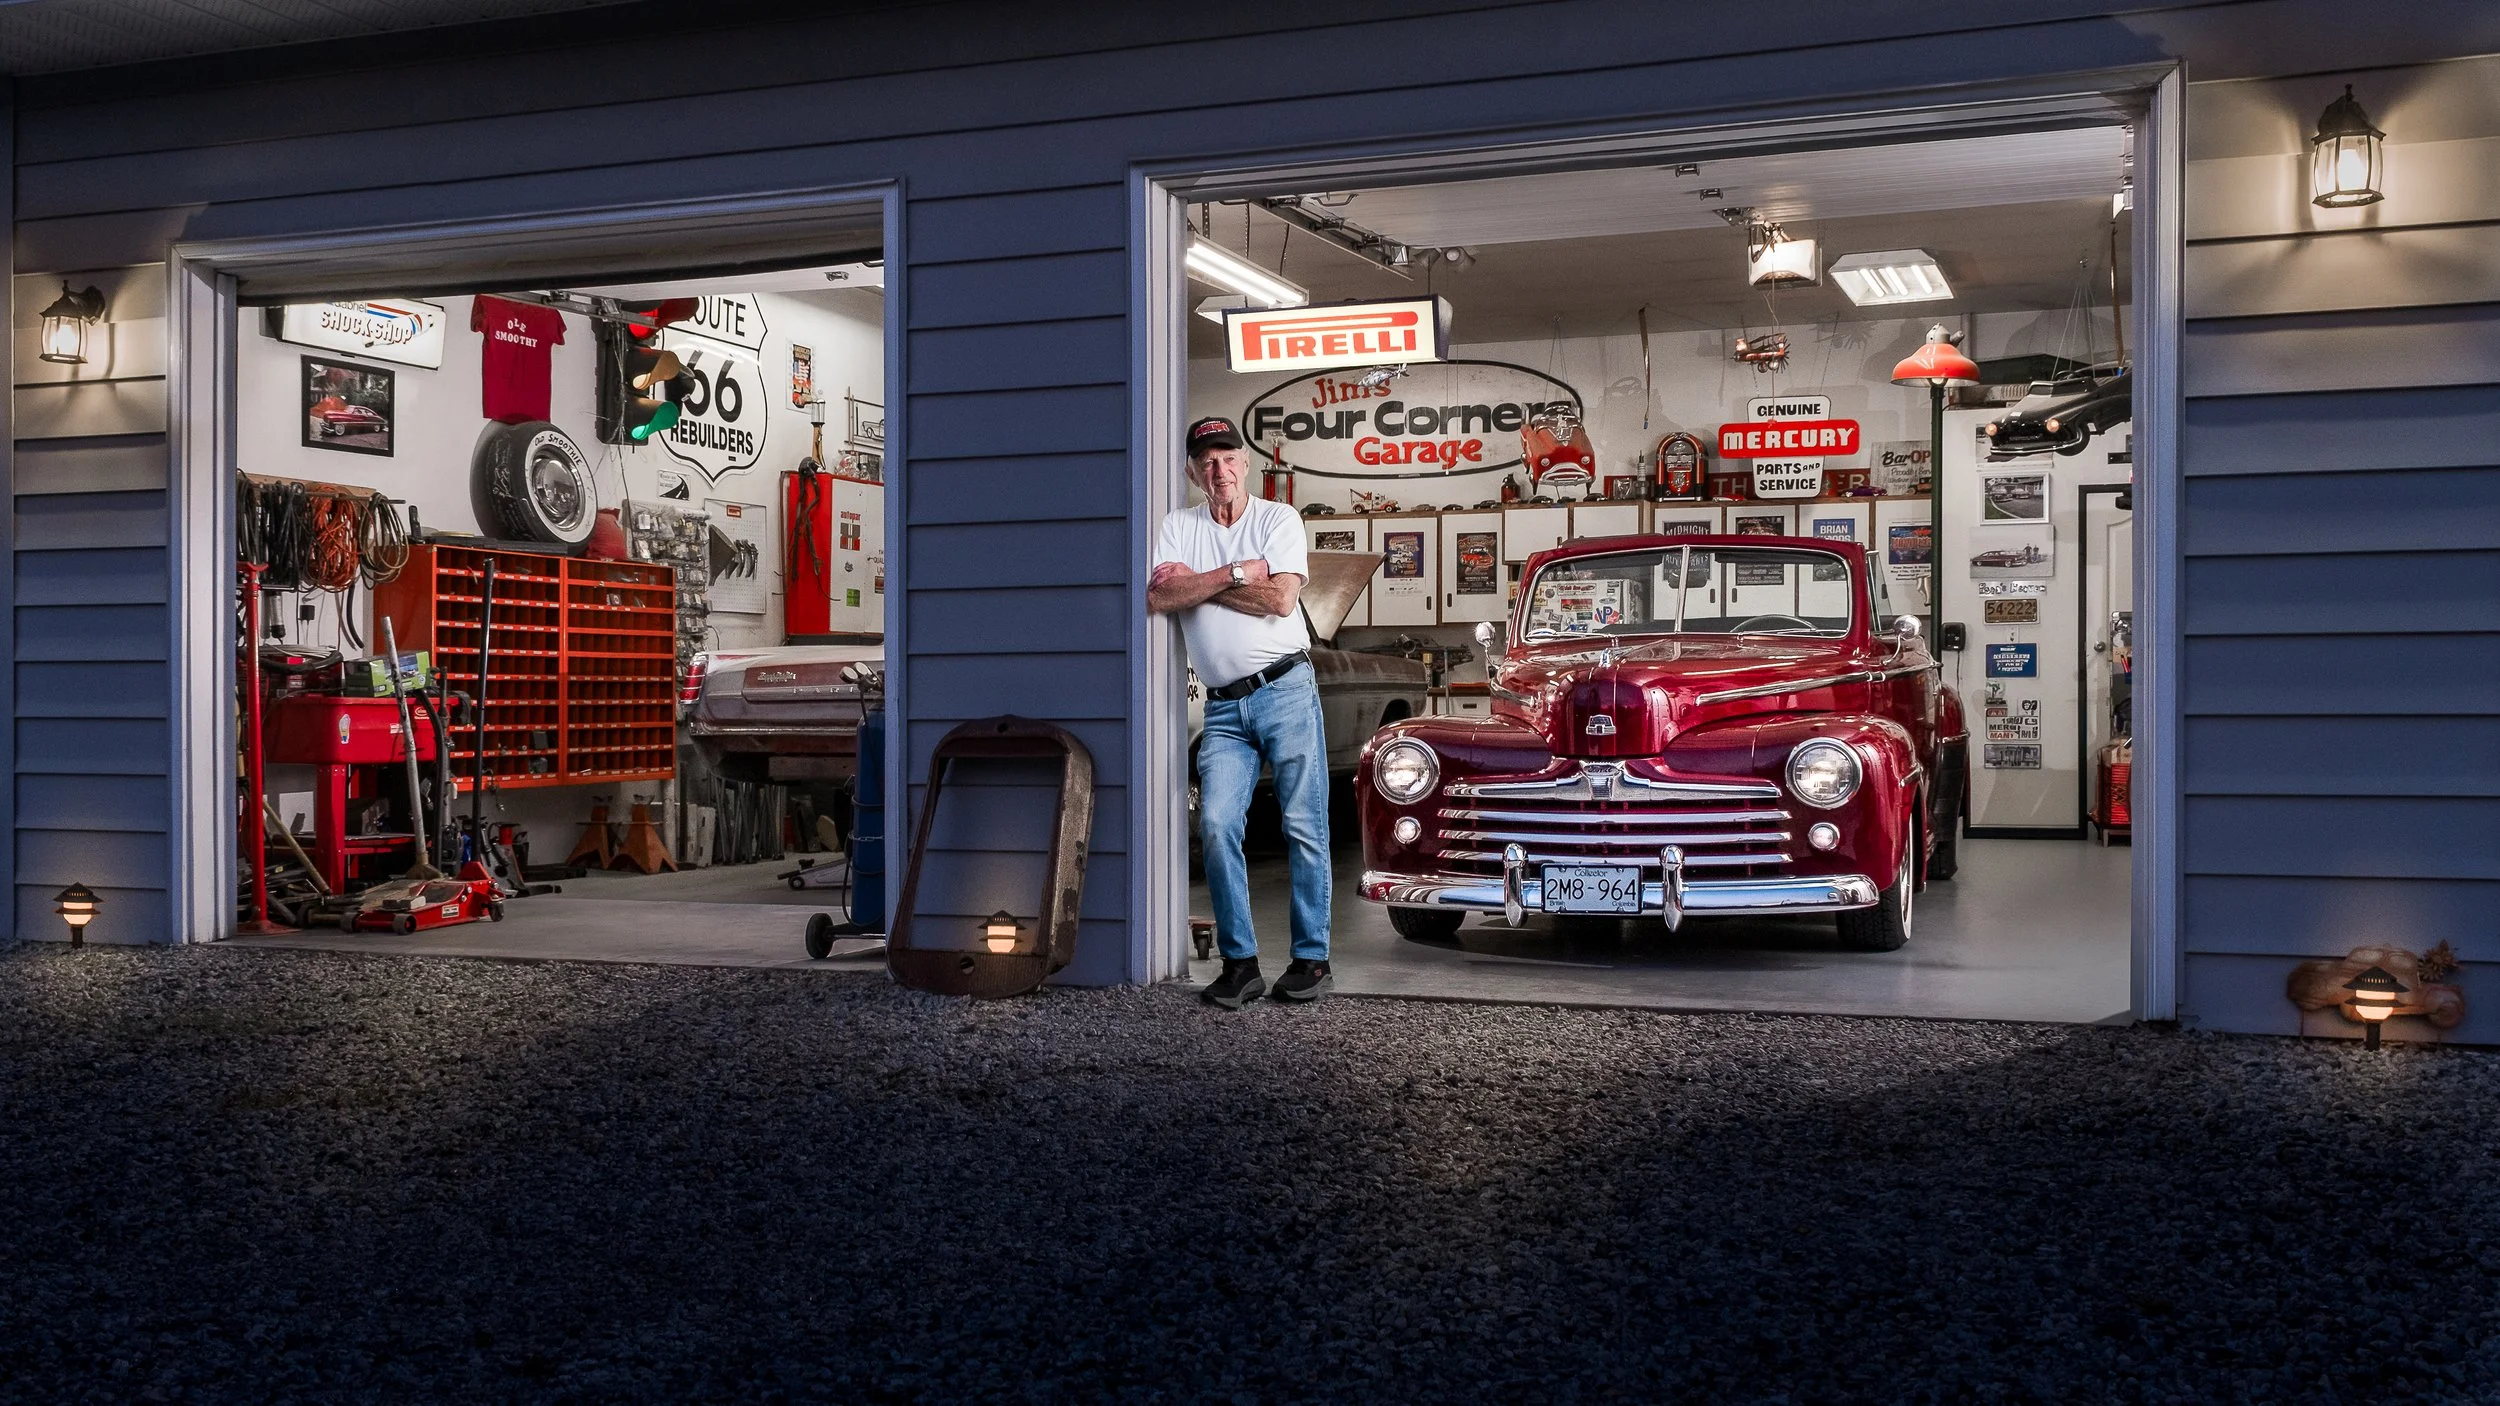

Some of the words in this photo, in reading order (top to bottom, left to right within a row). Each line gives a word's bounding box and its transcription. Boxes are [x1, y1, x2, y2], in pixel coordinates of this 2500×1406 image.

[695, 296, 746, 337] OUTE
[495, 330, 538, 347] SMOOTHY
[1241, 311, 1418, 360] PIRELLI
[684, 350, 743, 423] 66
[1757, 403, 1821, 417] GENUINE
[1254, 406, 1366, 441] Four
[670, 418, 753, 456] REBUILDERS
[1723, 427, 1856, 450] MERCURY
[1353, 437, 1483, 469] Garage
[1911, 450, 1931, 464] OP
[1756, 463, 1802, 475] PARTS
[1802, 463, 1821, 471] AND
[1759, 478, 1816, 491] SERVICE
[1820, 525, 1848, 534] BRIAN
[1665, 554, 1682, 565] AUT
[1574, 868, 1608, 877] Collector
[1546, 878, 1637, 901] 2M8-964
